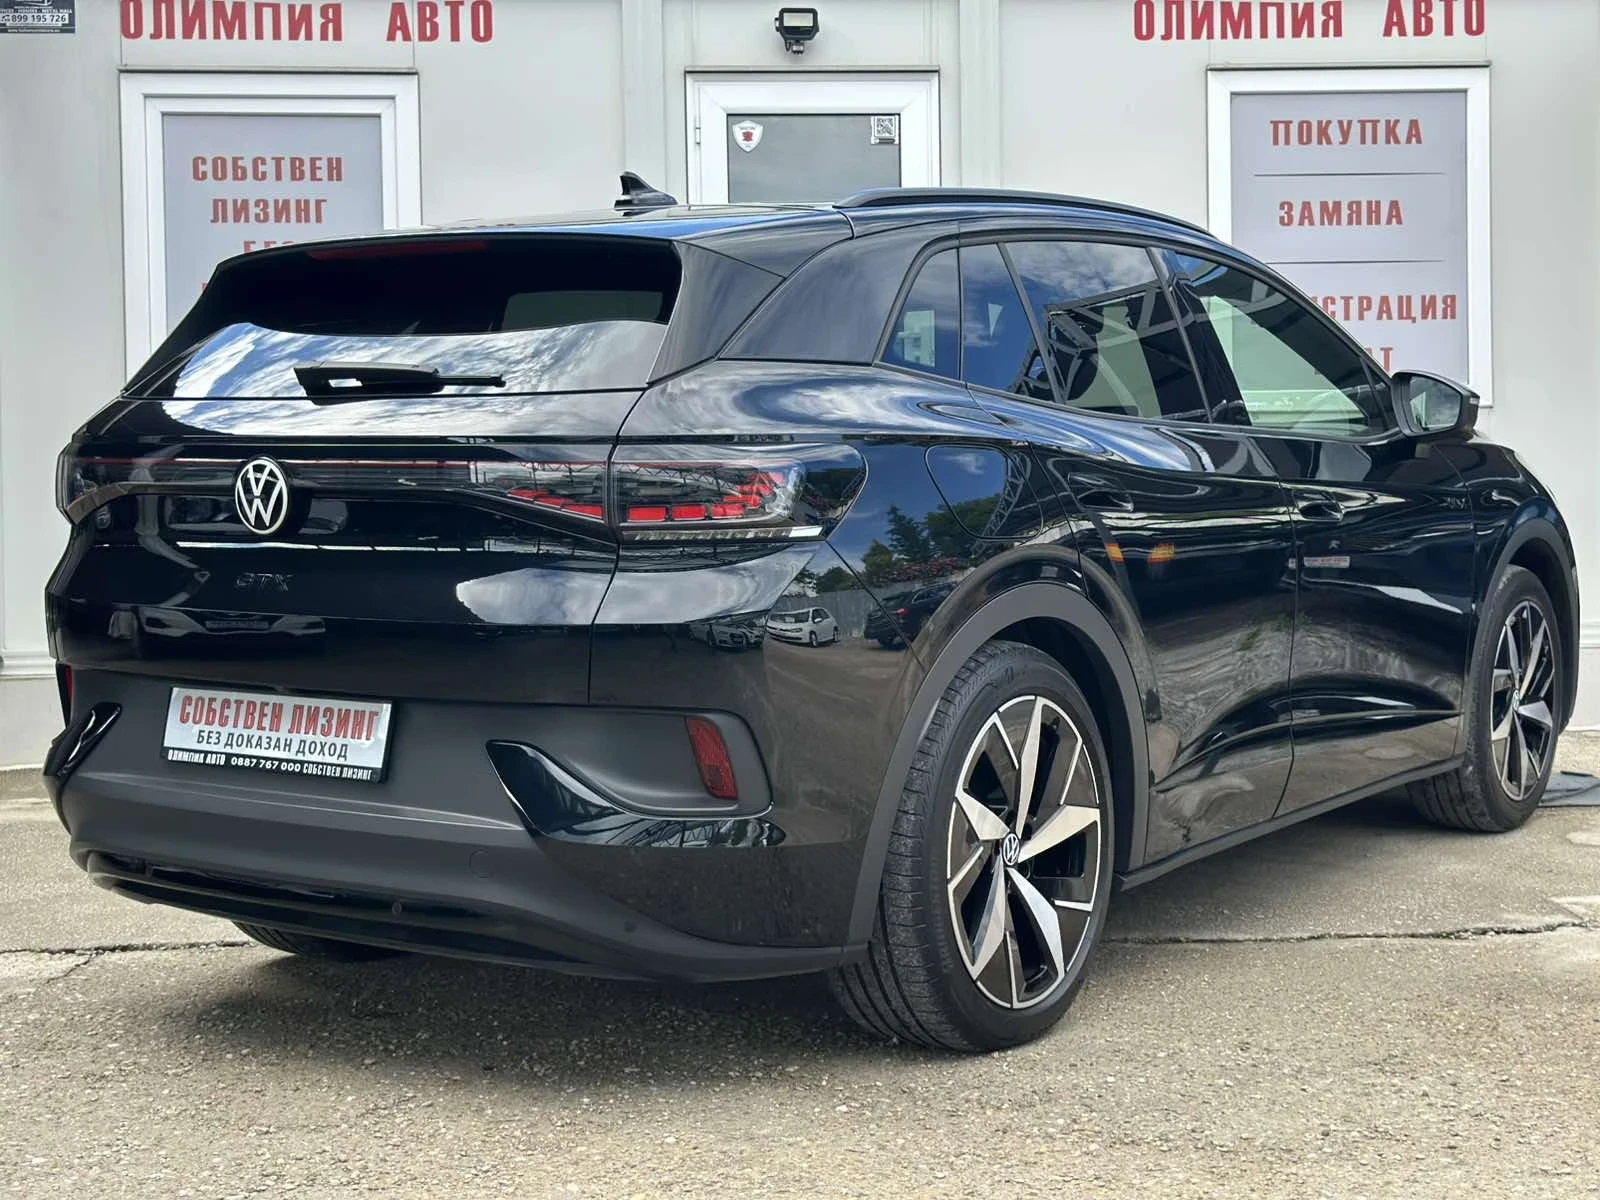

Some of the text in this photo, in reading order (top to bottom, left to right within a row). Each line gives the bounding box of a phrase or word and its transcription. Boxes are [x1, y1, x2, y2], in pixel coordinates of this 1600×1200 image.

[11, 14, 67, 22] 899 195 726
[120, 0, 493, 43] ОЛИМПИЯ АВТО
[1134, 0, 1485, 41] ОЛИМПИЯ АВТО
[1270, 119, 1423, 146] ПОКУПКА
[192, 156, 344, 182] СОБСТВЕН
[210, 199, 328, 224] ЛИЗИНГ
[1279, 200, 1403, 227] ЗАМЯНА
[1312, 294, 1457, 323] СТРАЦИЯ
[179, 695, 379, 741] СОБСТВЕН ЛИЗИНГ
[197, 729, 349, 762] БЕЗ ДОКАЗАН ДОХОД
[205, 753, 226, 766] АВТО
[231, 756, 257, 767] 0887
[259, 759, 279, 770] 767
[281, 762, 301, 772] 000
[303, 763, 342, 777] СОБСТВЕН
[342, 767, 372, 780] ЛИЗИНГ
